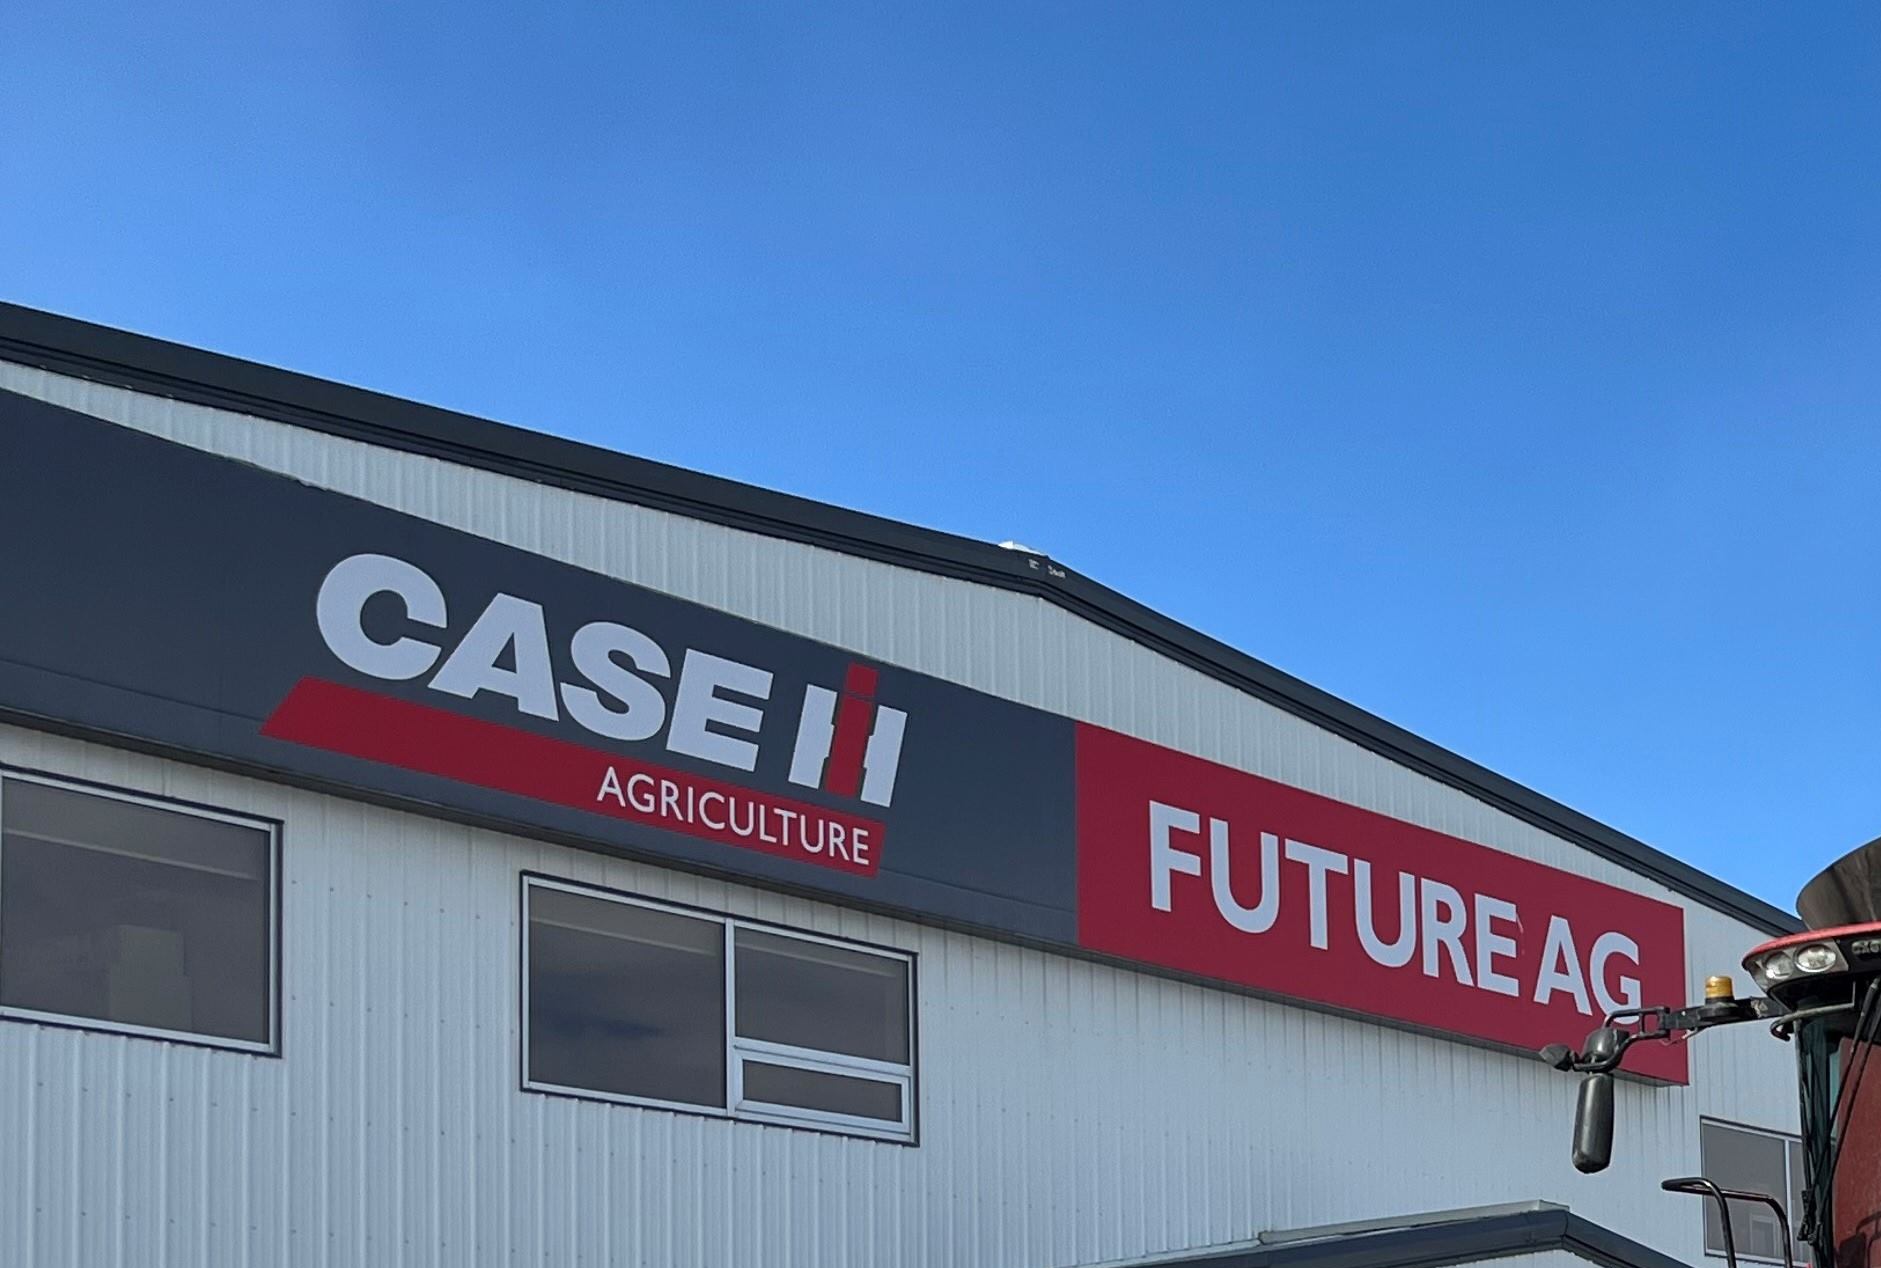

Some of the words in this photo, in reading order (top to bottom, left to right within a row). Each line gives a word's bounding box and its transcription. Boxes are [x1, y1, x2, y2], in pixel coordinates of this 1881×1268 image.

[316, 552, 774, 772] CASE
[597, 766, 871, 866] AGRICULTURE
[1149, 800, 1520, 997] FUTURE
[1534, 915, 1643, 1025] AG
